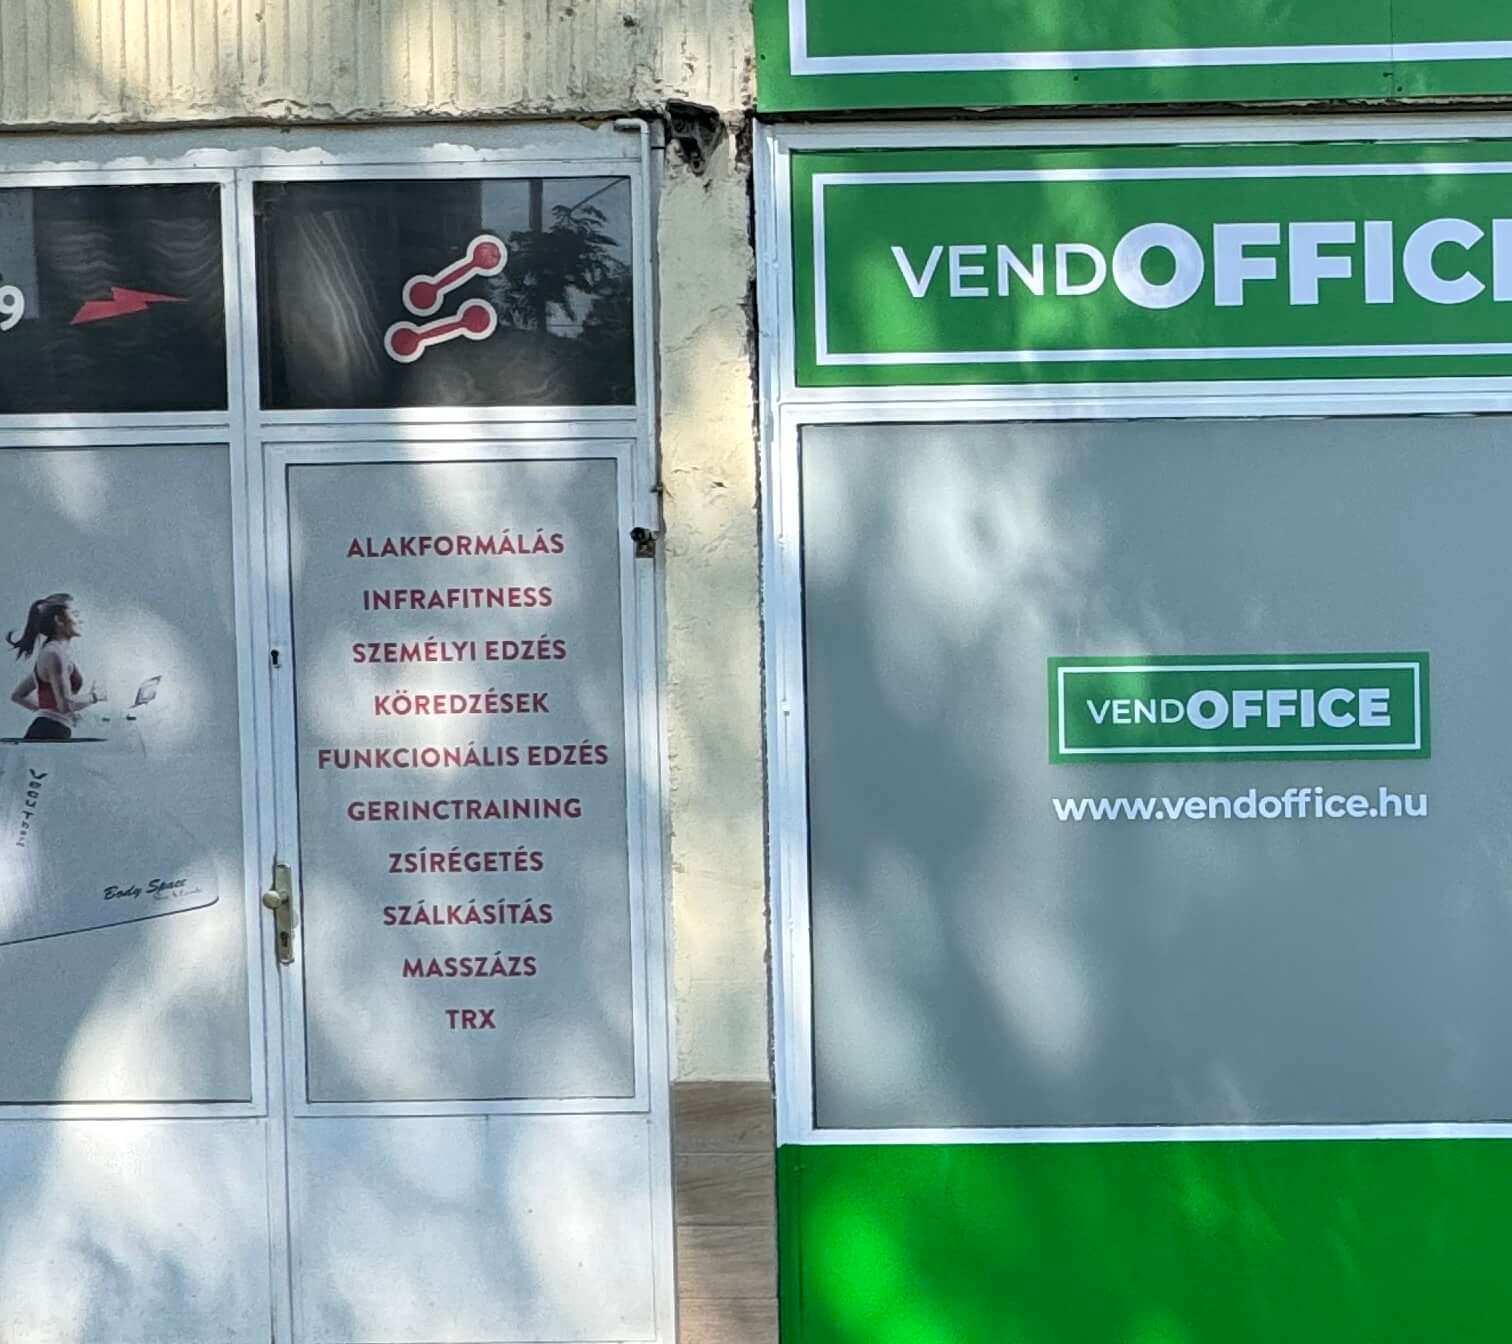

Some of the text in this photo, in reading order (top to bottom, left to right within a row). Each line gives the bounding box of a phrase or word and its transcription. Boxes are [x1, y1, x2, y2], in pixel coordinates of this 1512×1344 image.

[347, 528, 565, 557] ALAKFORMÁLÁS
[363, 586, 553, 609] INFRAFITNESS
[351, 636, 567, 665] SZEMÉLYI EDZÉS
[372, 688, 550, 716] KÖREDZÉSEK
[1086, 684, 1391, 730] VENDOFFICE
[318, 741, 608, 769] FUNKCIONÁLIS EDZÉS
[345, 799, 582, 822] GERINCTRAINING
[1047, 783, 1428, 822] www.vendoffice.hu
[388, 846, 542, 875] ZSÍRÉGETÉS
[384, 901, 552, 928] SZÁLKÁSÍTÁS
[400, 953, 537, 979] MASSZÁZS
[446, 1008, 496, 1029] TRX
